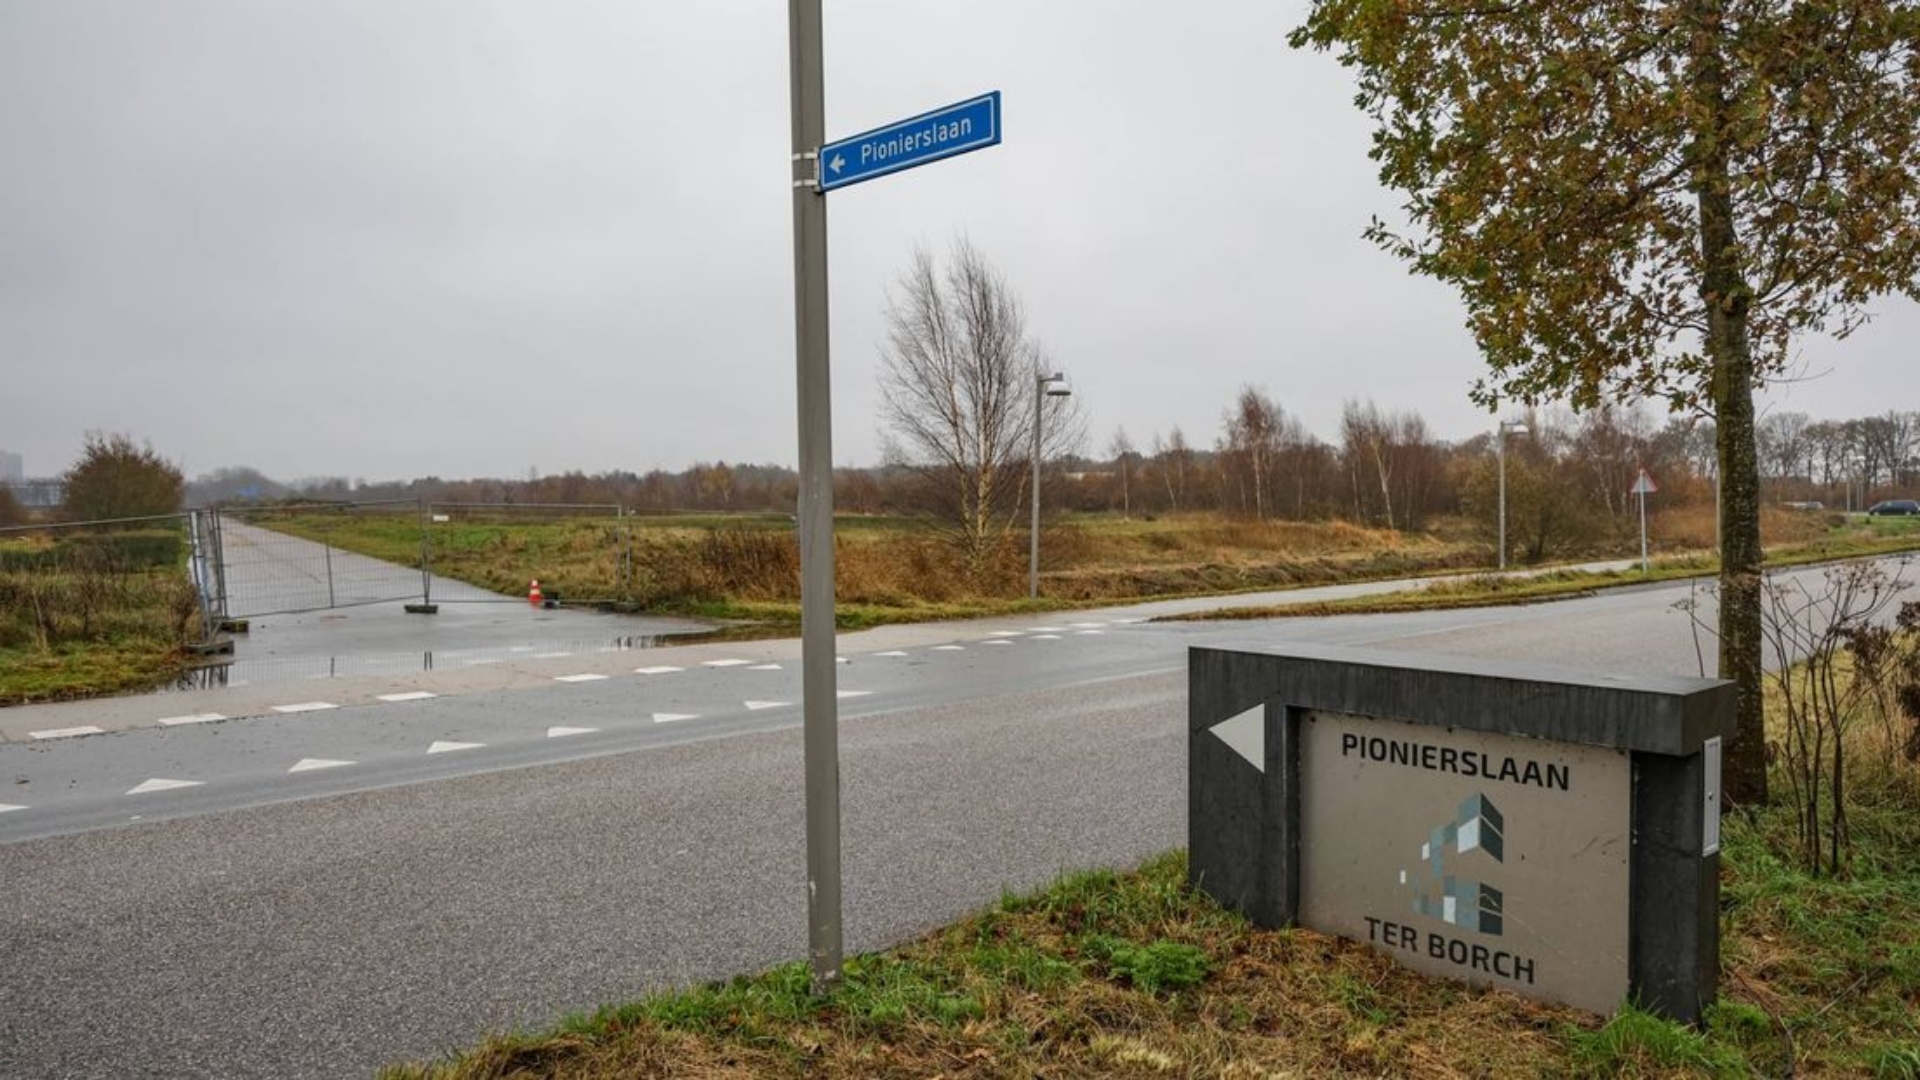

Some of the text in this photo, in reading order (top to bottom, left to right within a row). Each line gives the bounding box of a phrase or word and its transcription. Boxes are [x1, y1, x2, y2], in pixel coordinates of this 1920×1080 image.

[861, 117, 971, 165] Pionierslaan
[1342, 733, 1569, 791] PIONIERSLAAN
[1364, 917, 1535, 984] TER BORCH
